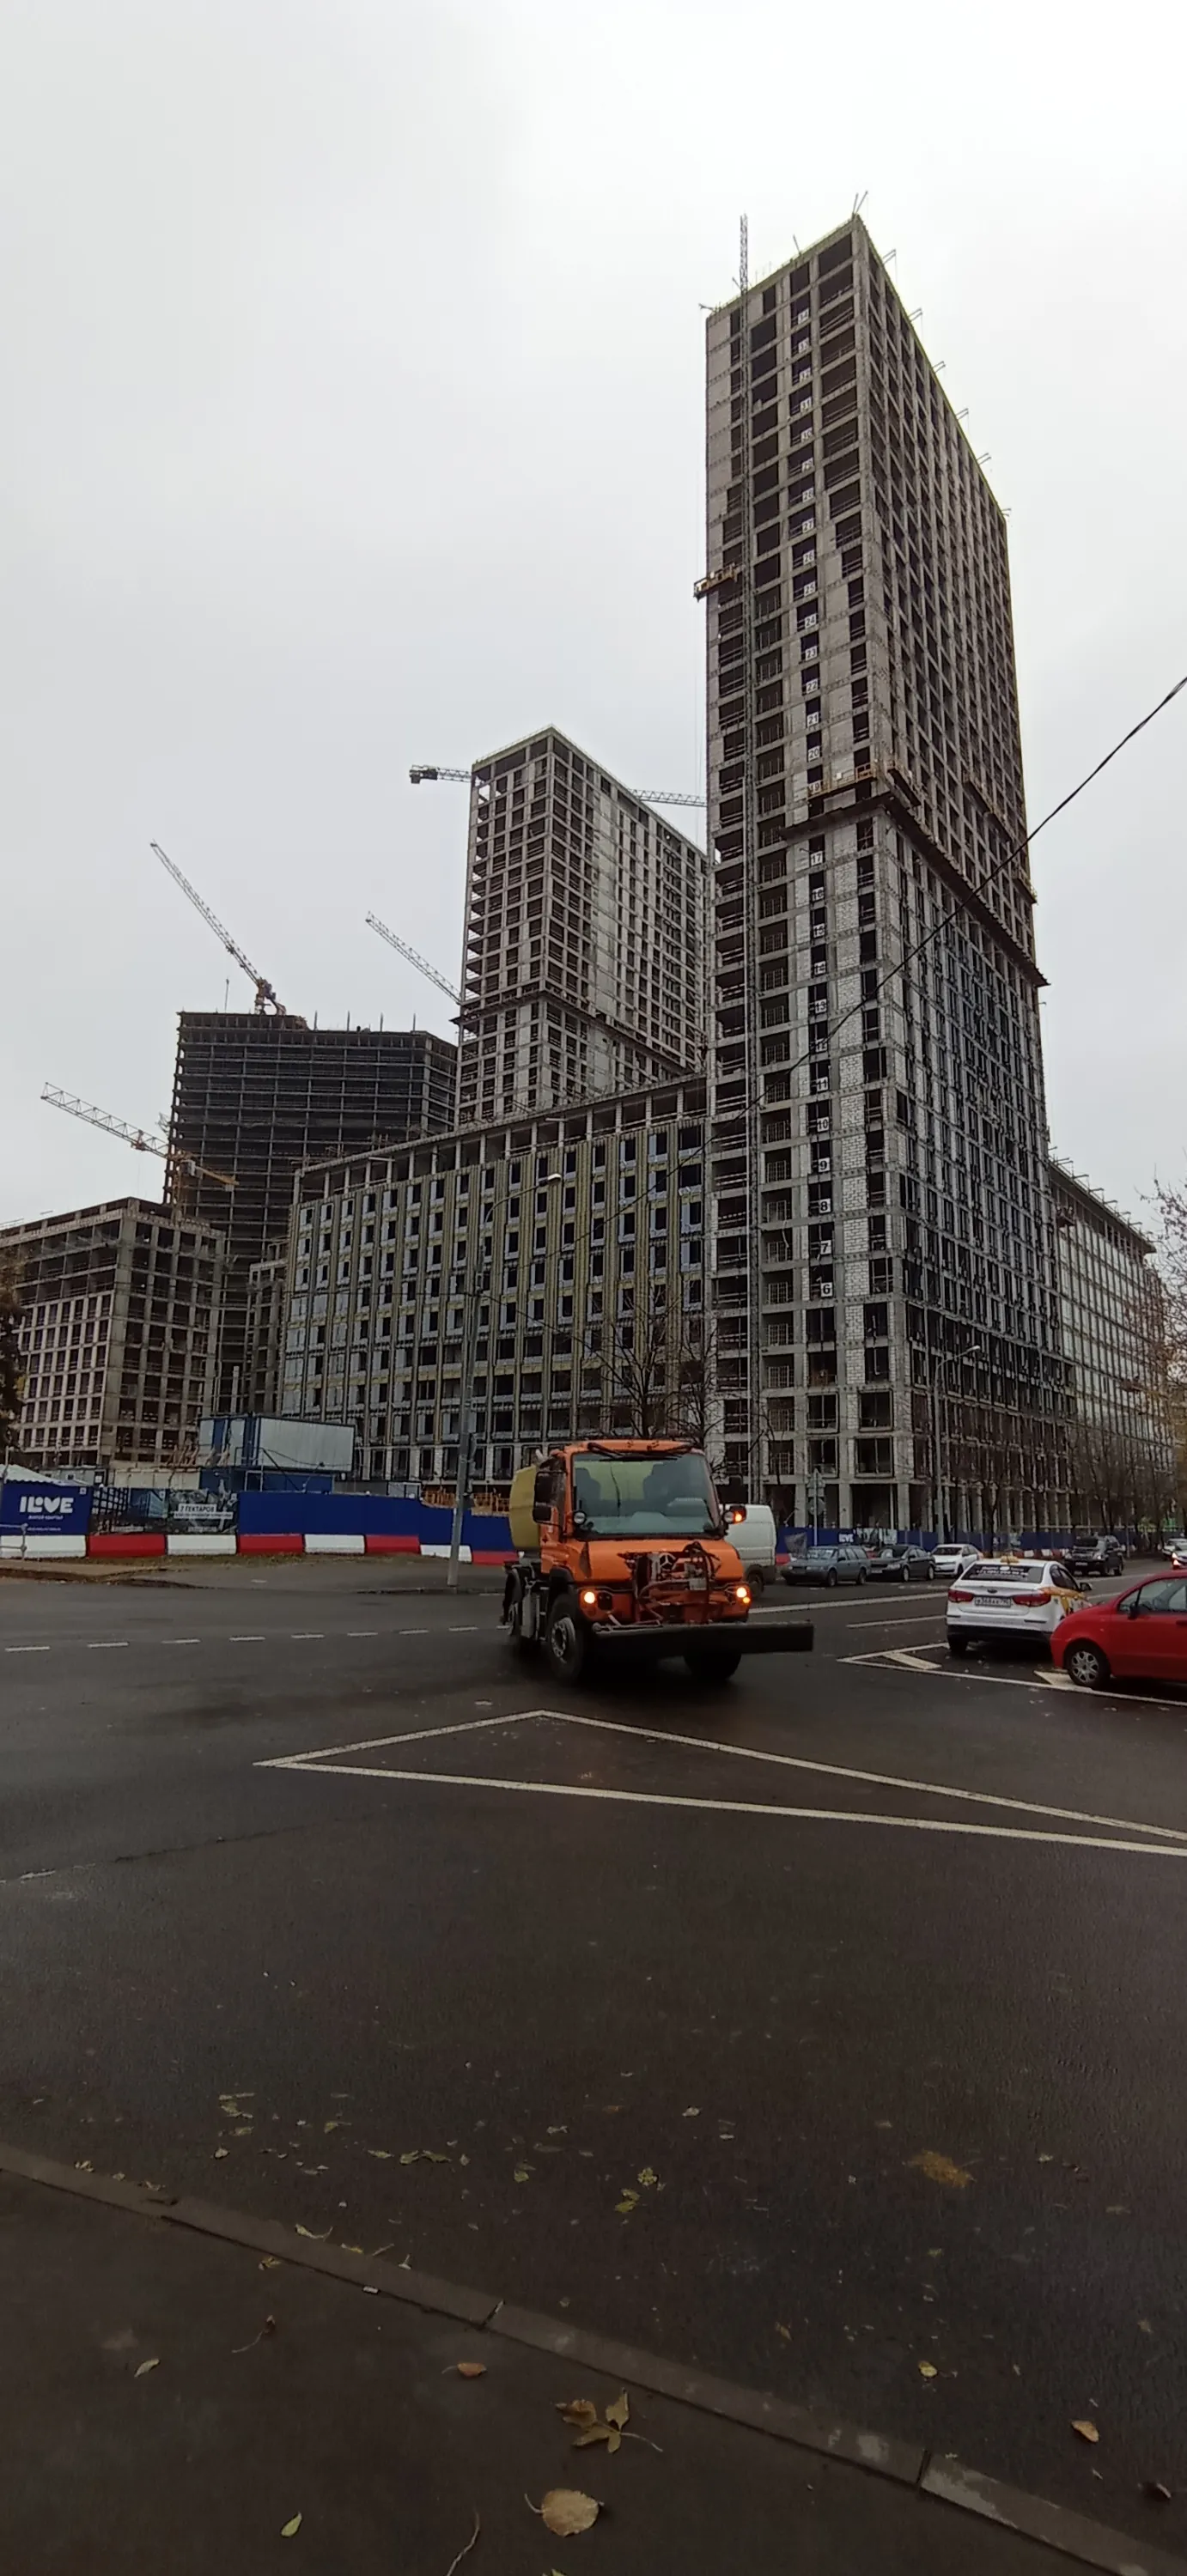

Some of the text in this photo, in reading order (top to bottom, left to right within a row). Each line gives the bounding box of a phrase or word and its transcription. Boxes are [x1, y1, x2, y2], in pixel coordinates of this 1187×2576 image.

[805, 583, 815, 595] 25
[806, 615, 816, 627] 24
[807, 647, 817, 659] 23
[807, 679, 818, 691] 22
[808, 714, 819, 725] 21
[809, 747, 819, 758] 20
[812, 852, 822, 864] 17
[813, 888, 824, 900] 16
[813, 925, 825, 936] 15
[814, 962, 825, 973] 14
[815, 1000, 827, 1012] 13
[817, 1078, 828, 1091] 11
[818, 1118, 829, 1130] 10
[186, 1504, 215, 1513] ГЕКТАРОВ
